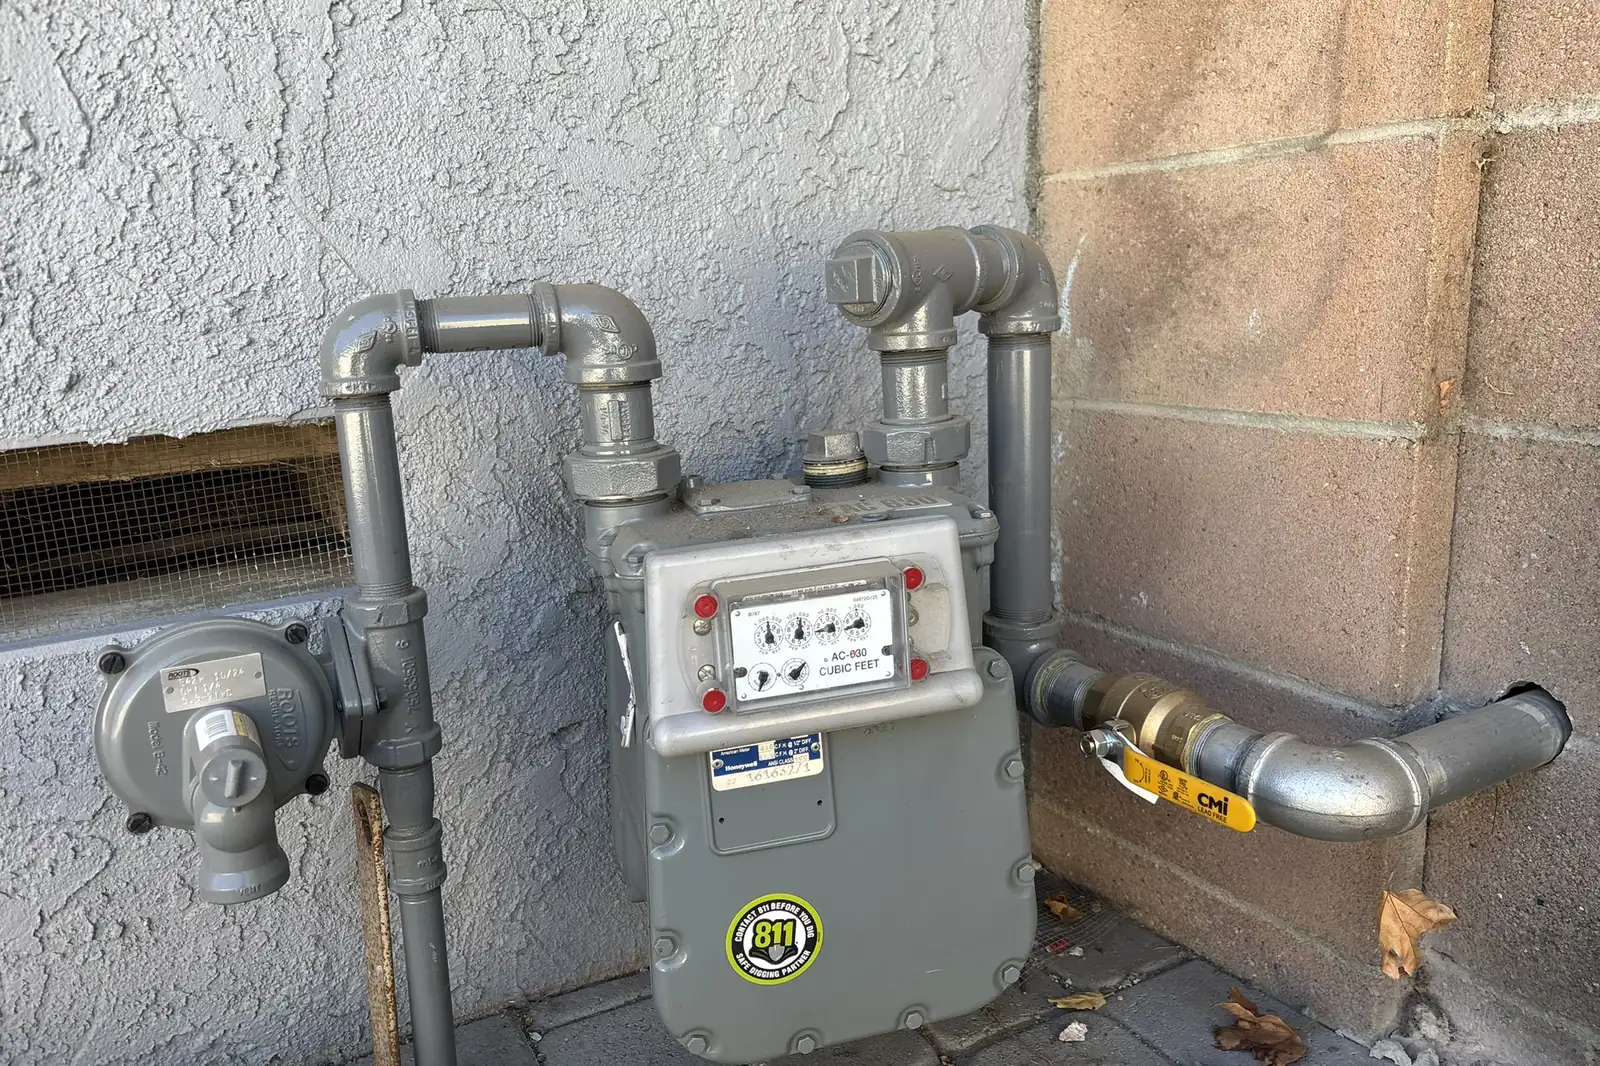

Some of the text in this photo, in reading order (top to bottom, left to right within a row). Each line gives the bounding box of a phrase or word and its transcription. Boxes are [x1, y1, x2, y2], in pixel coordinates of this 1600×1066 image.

[832, 648, 867, 661] AC-630
[819, 659, 879, 676] CUBIC FEET
[147, 721, 161, 749] Model
[725, 760, 758, 772] Honeywell
[1198, 806, 1227, 823] LEAD FREE
[734, 910, 758, 942] CONTACT
[757, 903, 770, 914] 811
[771, 902, 800, 915] BEFORE
[799, 911, 810, 926] YOU
[806, 925, 815, 939] DIG
[754, 921, 794, 948] 811
[735, 950, 811, 979] SAFE DIGGING PARTNER
